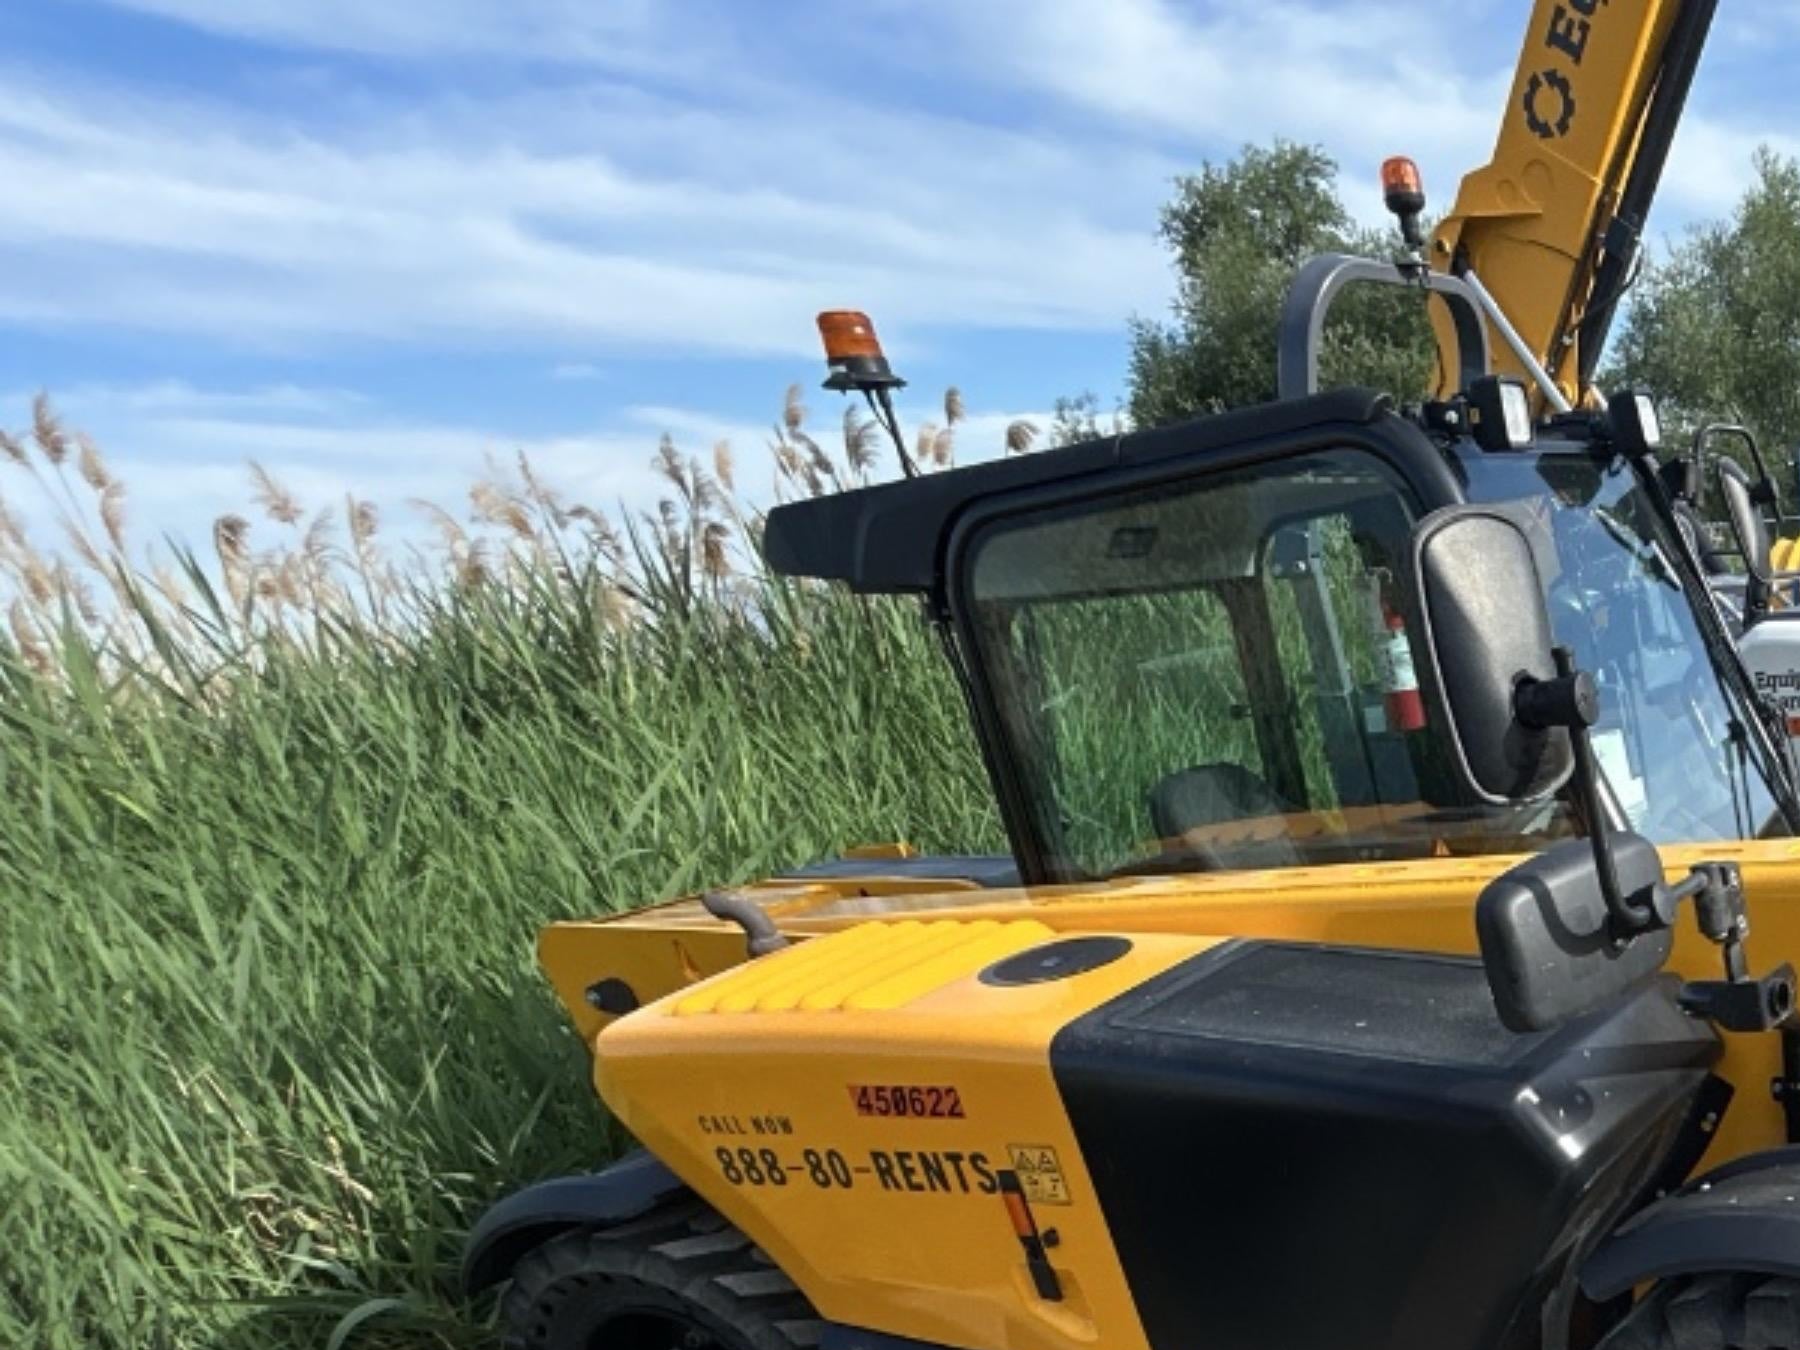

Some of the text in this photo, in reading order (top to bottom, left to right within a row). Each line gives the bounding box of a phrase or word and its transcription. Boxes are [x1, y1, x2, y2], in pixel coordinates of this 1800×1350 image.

[857, 1086, 966, 1118] 450622
[698, 1115, 793, 1135] CALL NOW
[716, 1146, 998, 1194] 888-80-RENTS
